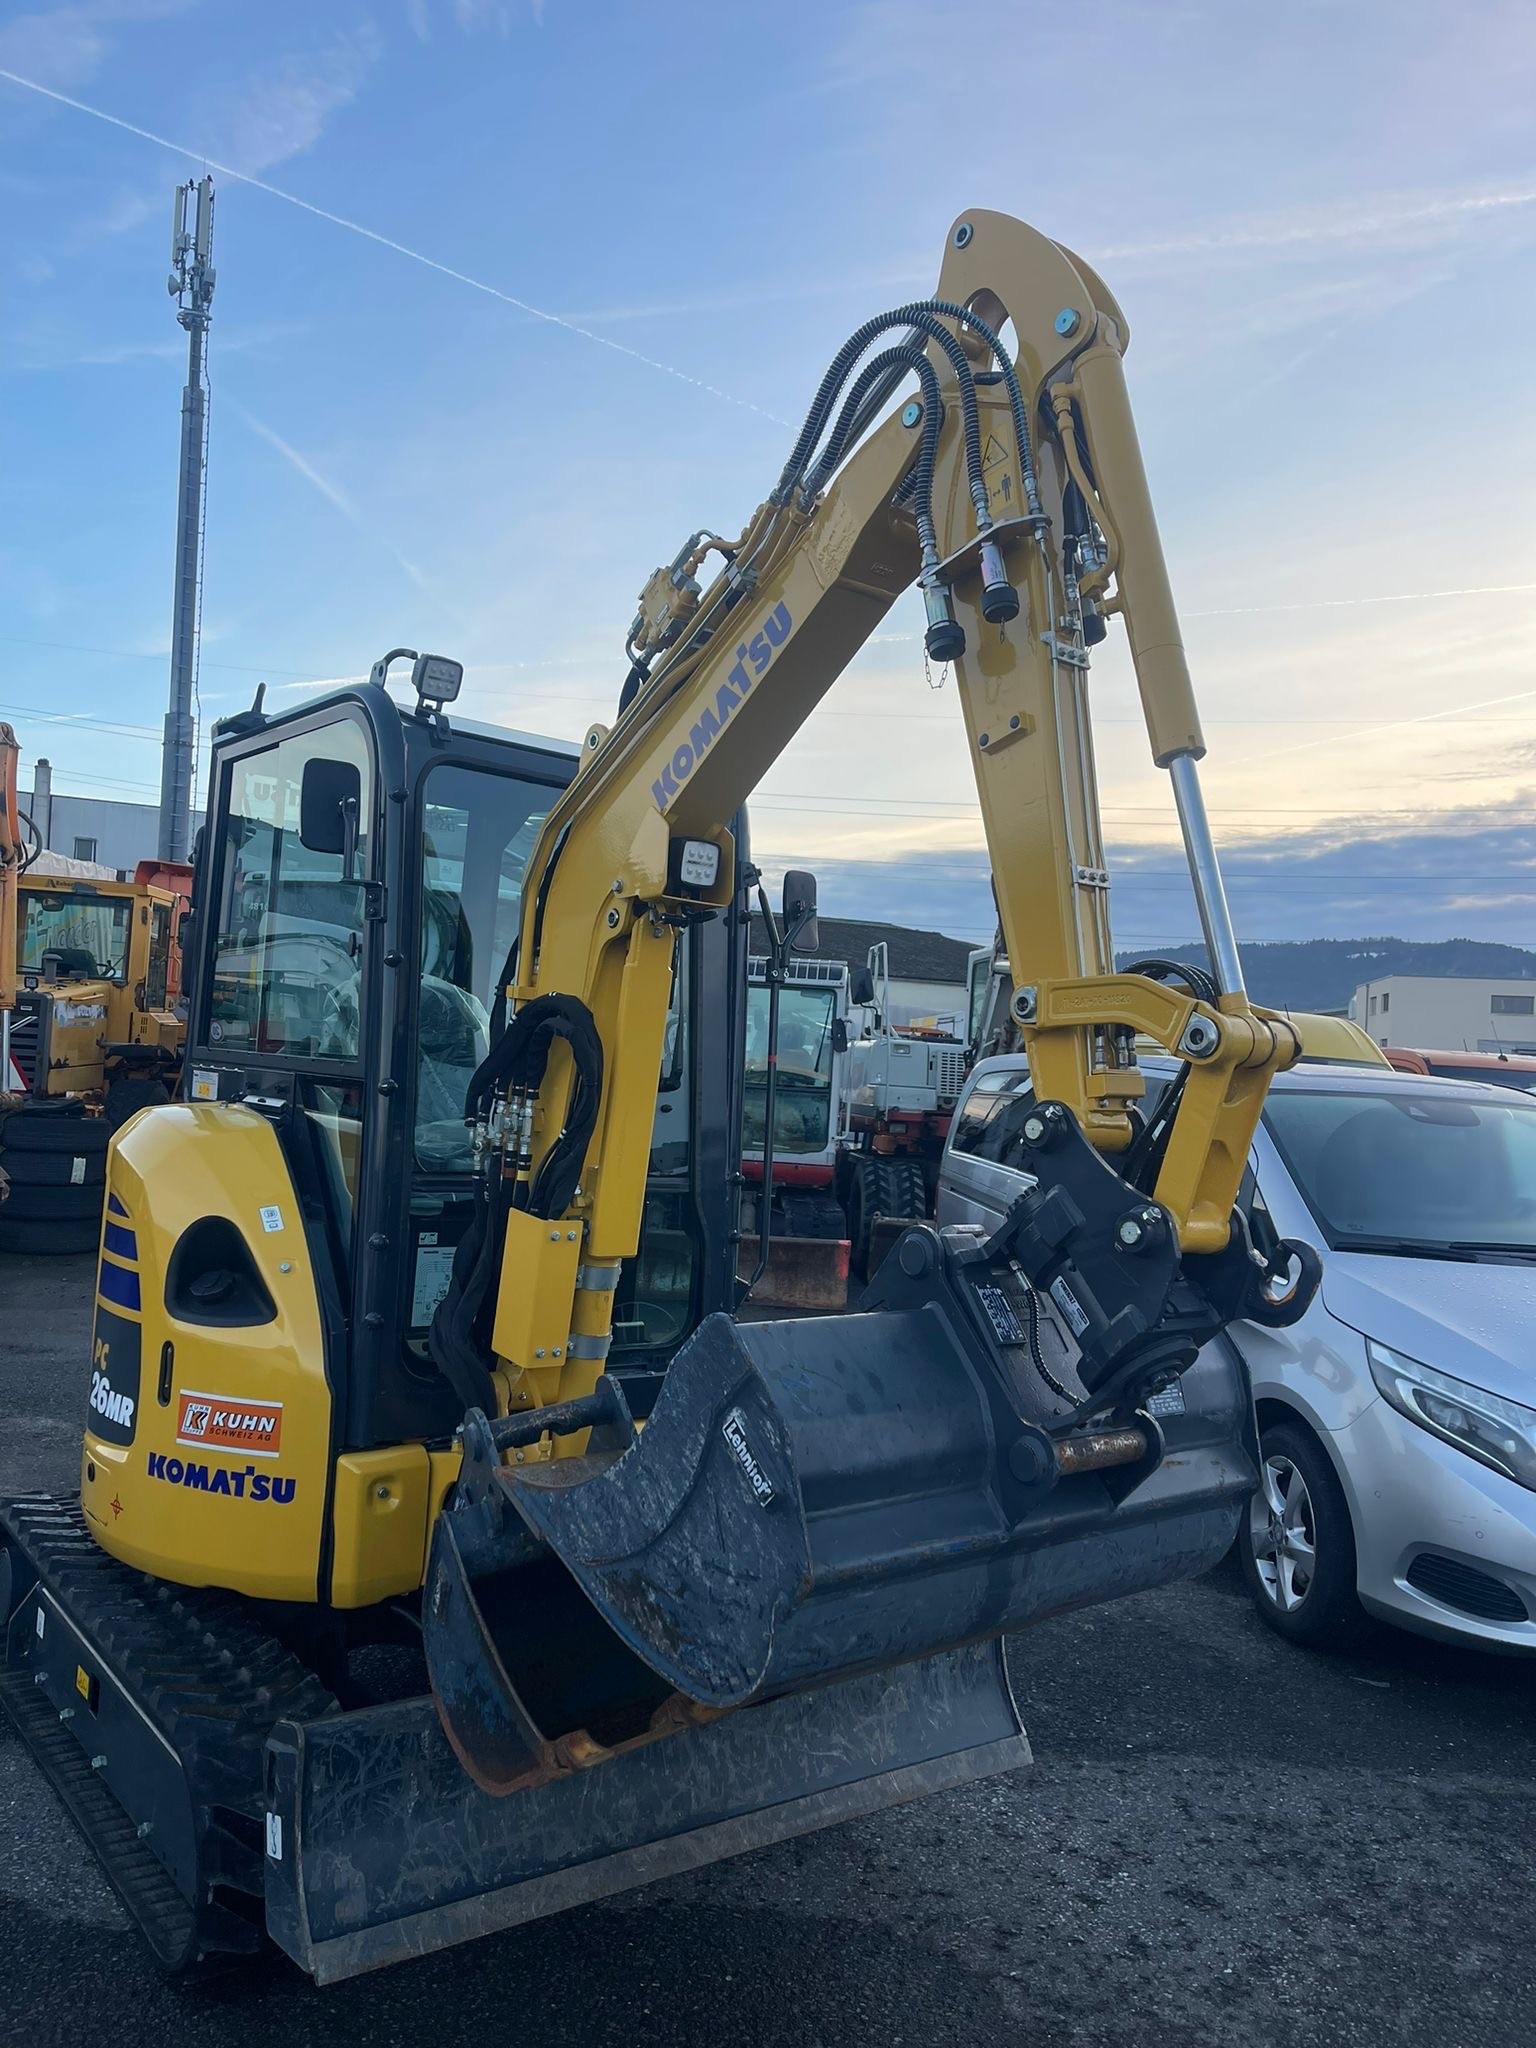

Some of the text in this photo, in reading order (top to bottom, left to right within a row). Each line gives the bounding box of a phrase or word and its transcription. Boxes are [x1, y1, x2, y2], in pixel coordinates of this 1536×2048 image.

[651, 600, 793, 811] KOMATSU
[95, 1338, 110, 1371] PC
[90, 1371, 134, 1428] 26MR
[209, 1427, 272, 1442] SCHWEIZ AG
[212, 1411, 277, 1433] KUHN
[148, 1452, 296, 1504] KOMATSU
